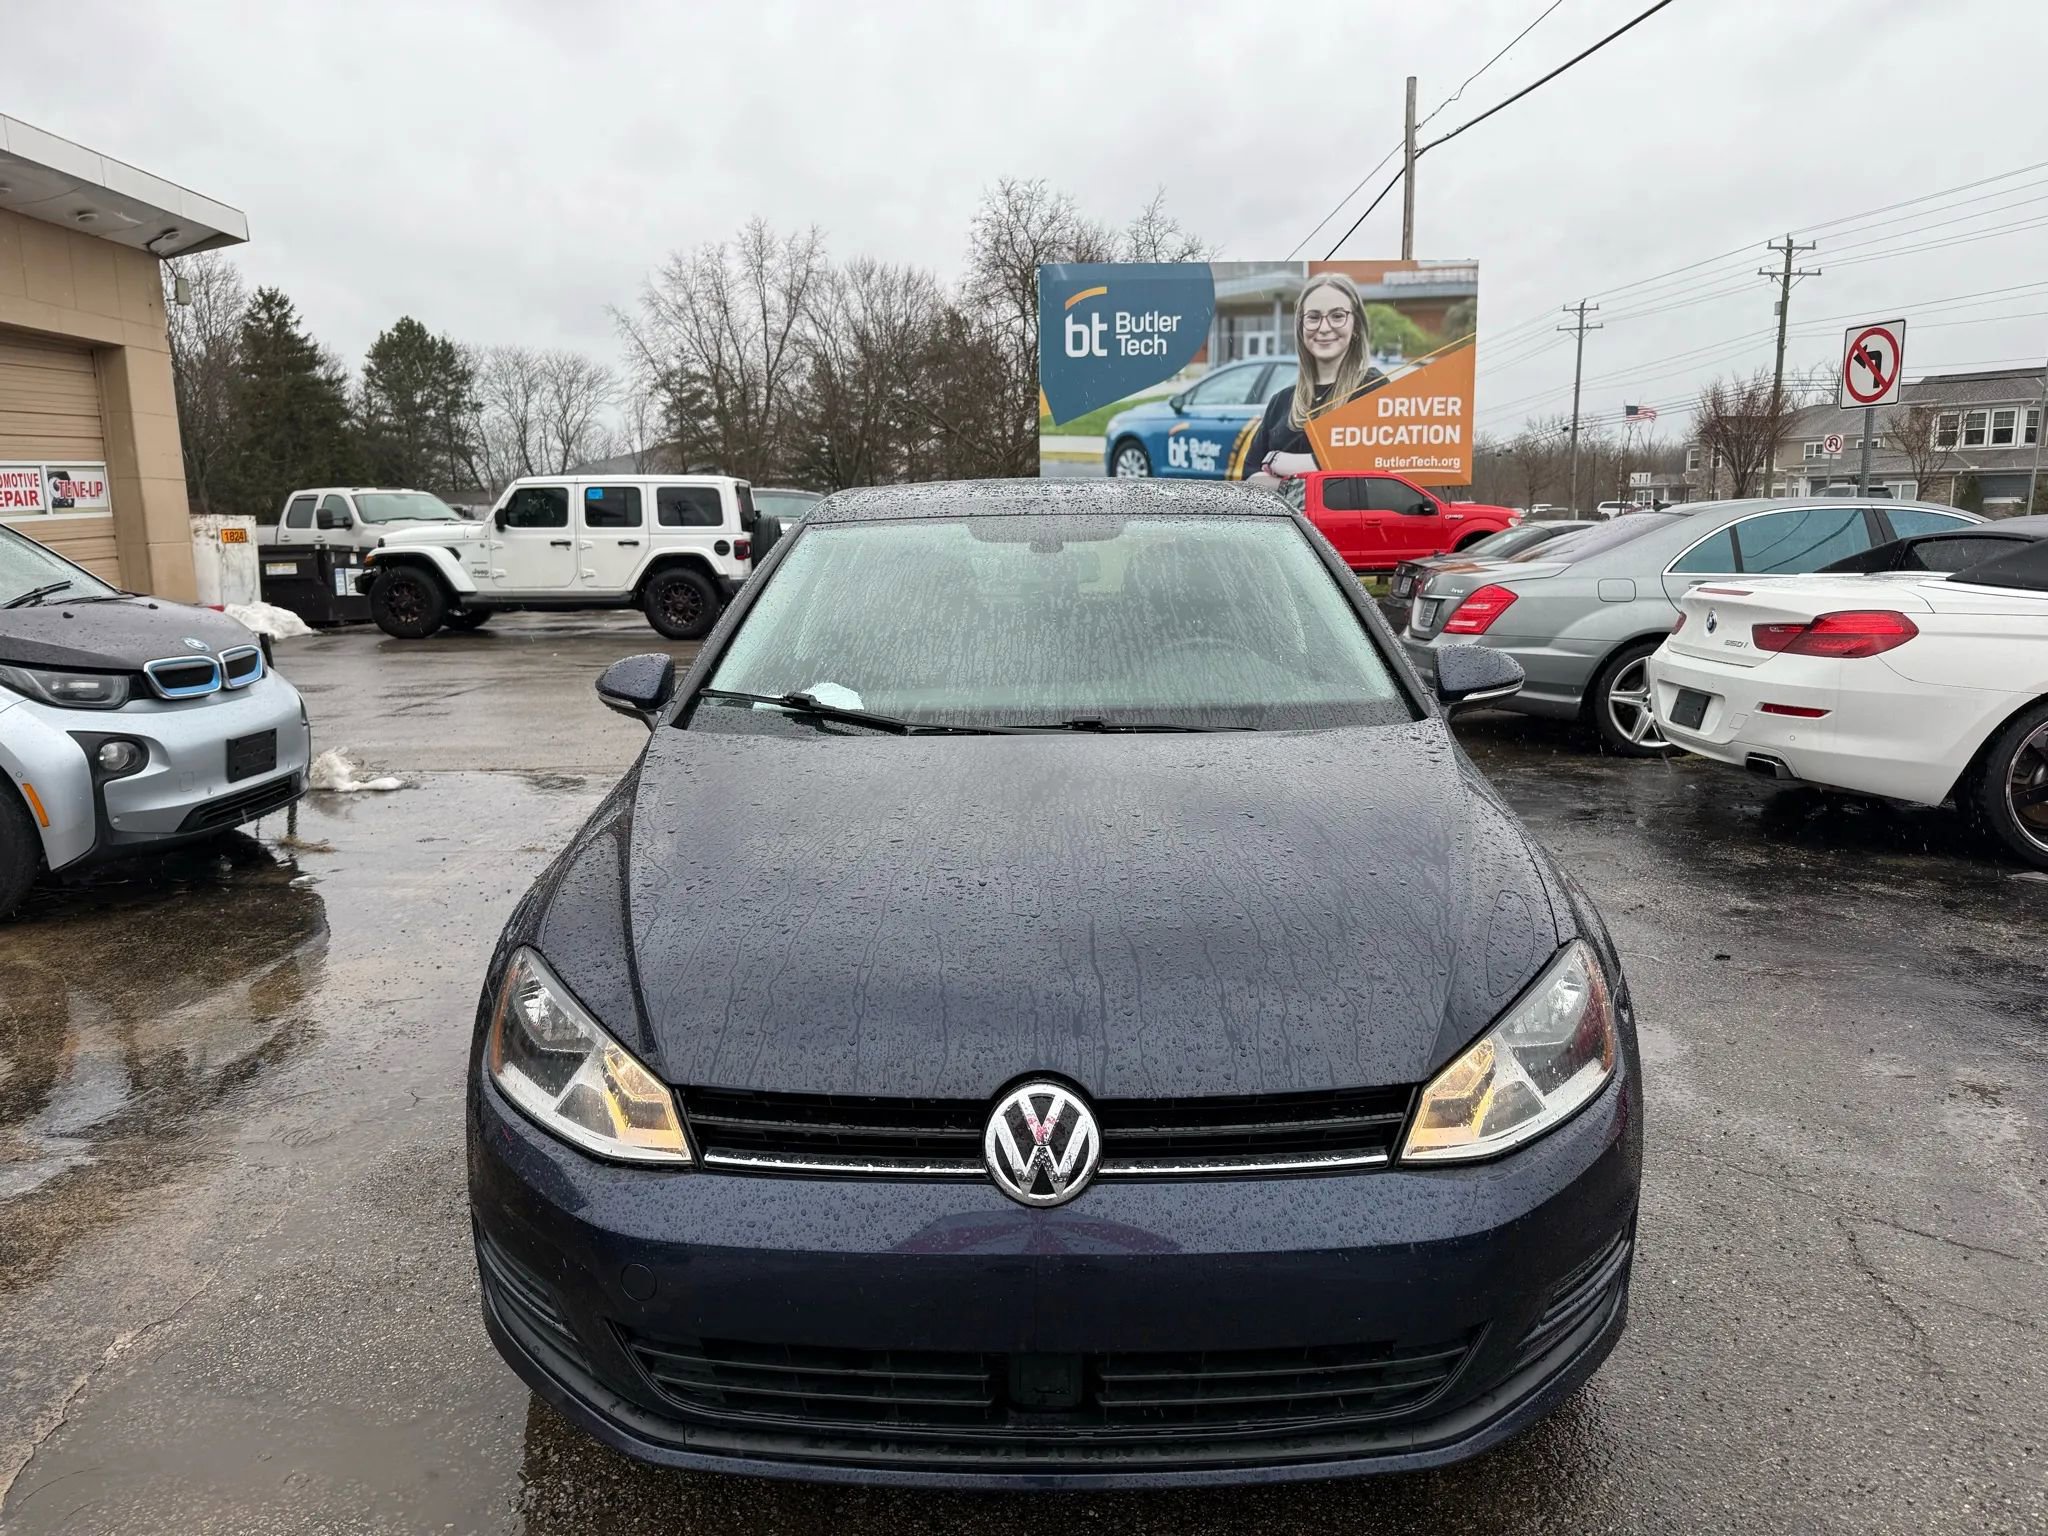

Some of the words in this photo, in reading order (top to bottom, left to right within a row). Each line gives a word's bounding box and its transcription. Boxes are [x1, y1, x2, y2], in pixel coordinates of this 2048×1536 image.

[1065, 312, 1108, 357] bt
[1115, 311, 1182, 333] Butler
[1115, 333, 1167, 356] Tech
[1377, 396, 1462, 418] DRIVER
[1330, 424, 1461, 447] EDUCATION
[1168, 436, 1189, 468] bt
[1374, 455, 1461, 469] ButlerTech.org
[58, 480, 103, 499] TUNE-UP
[224, 531, 245, 542] 1824
